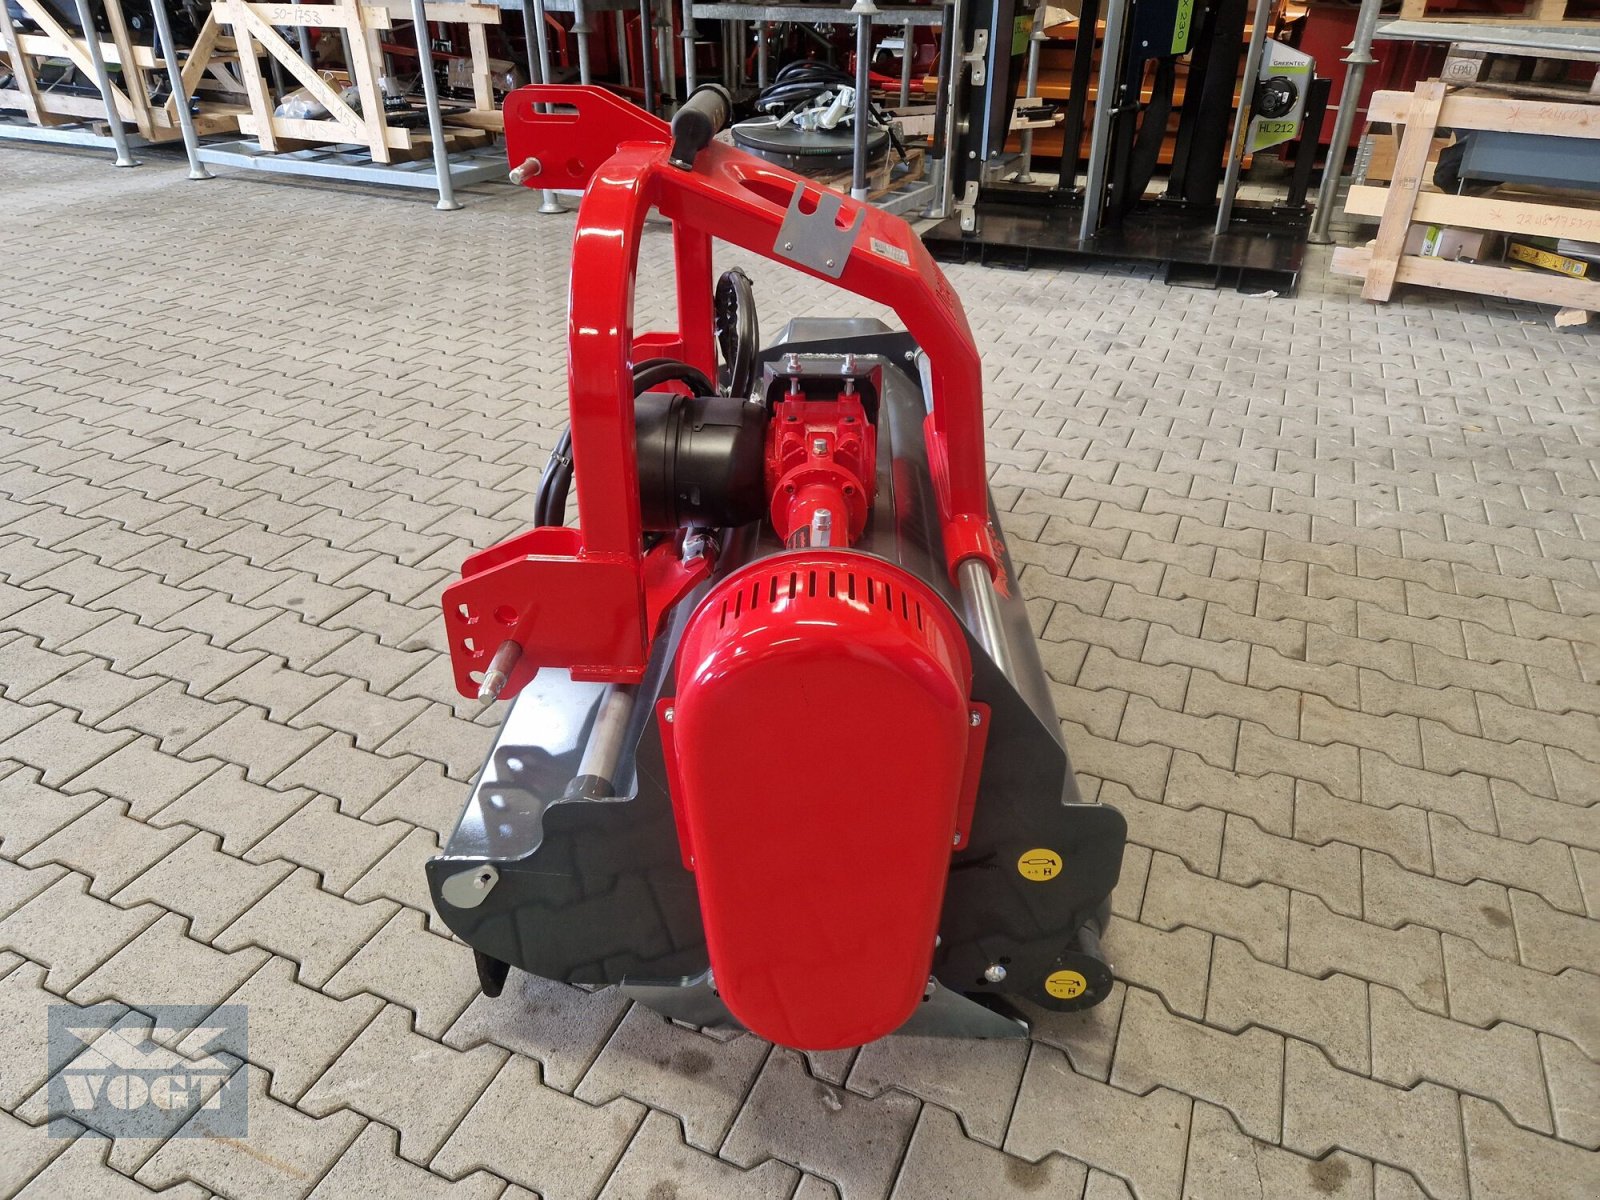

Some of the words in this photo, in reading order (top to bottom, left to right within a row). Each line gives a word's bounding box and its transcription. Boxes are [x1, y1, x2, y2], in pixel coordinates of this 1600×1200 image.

[1177, 13, 1188, 40] 230
[1259, 123, 1271, 133] HL
[1274, 123, 1294, 133] 212
